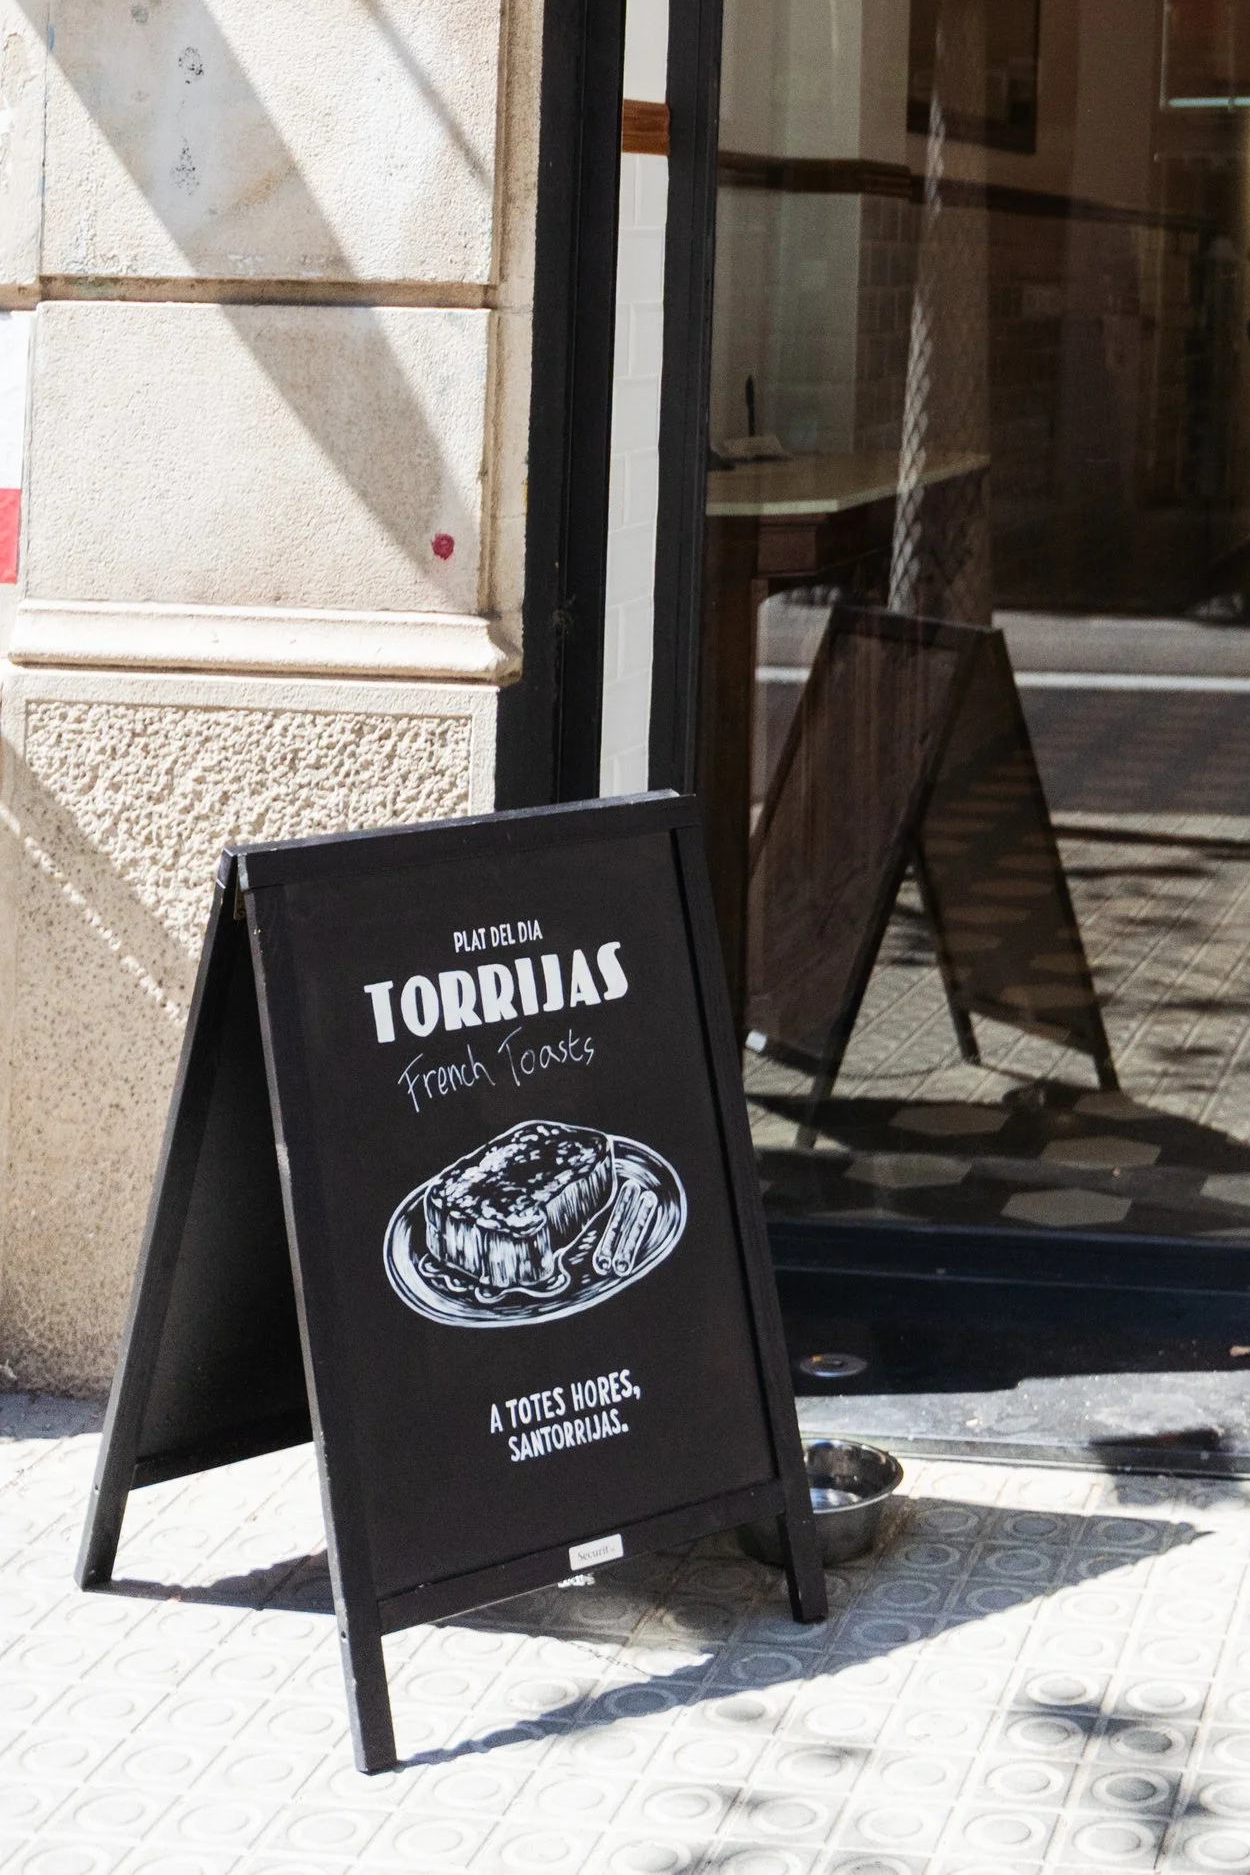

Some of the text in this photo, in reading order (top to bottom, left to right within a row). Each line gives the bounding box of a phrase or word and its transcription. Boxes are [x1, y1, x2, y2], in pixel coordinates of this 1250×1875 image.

[453, 919, 544, 954] PLAT DEL DIA
[363, 941, 629, 1044] TORRIJAS
[397, 1026, 595, 1113] French Toasts
[491, 1369, 641, 1434] A TOTES HORES,
[508, 1408, 630, 1463] SANTORRIJAS.
